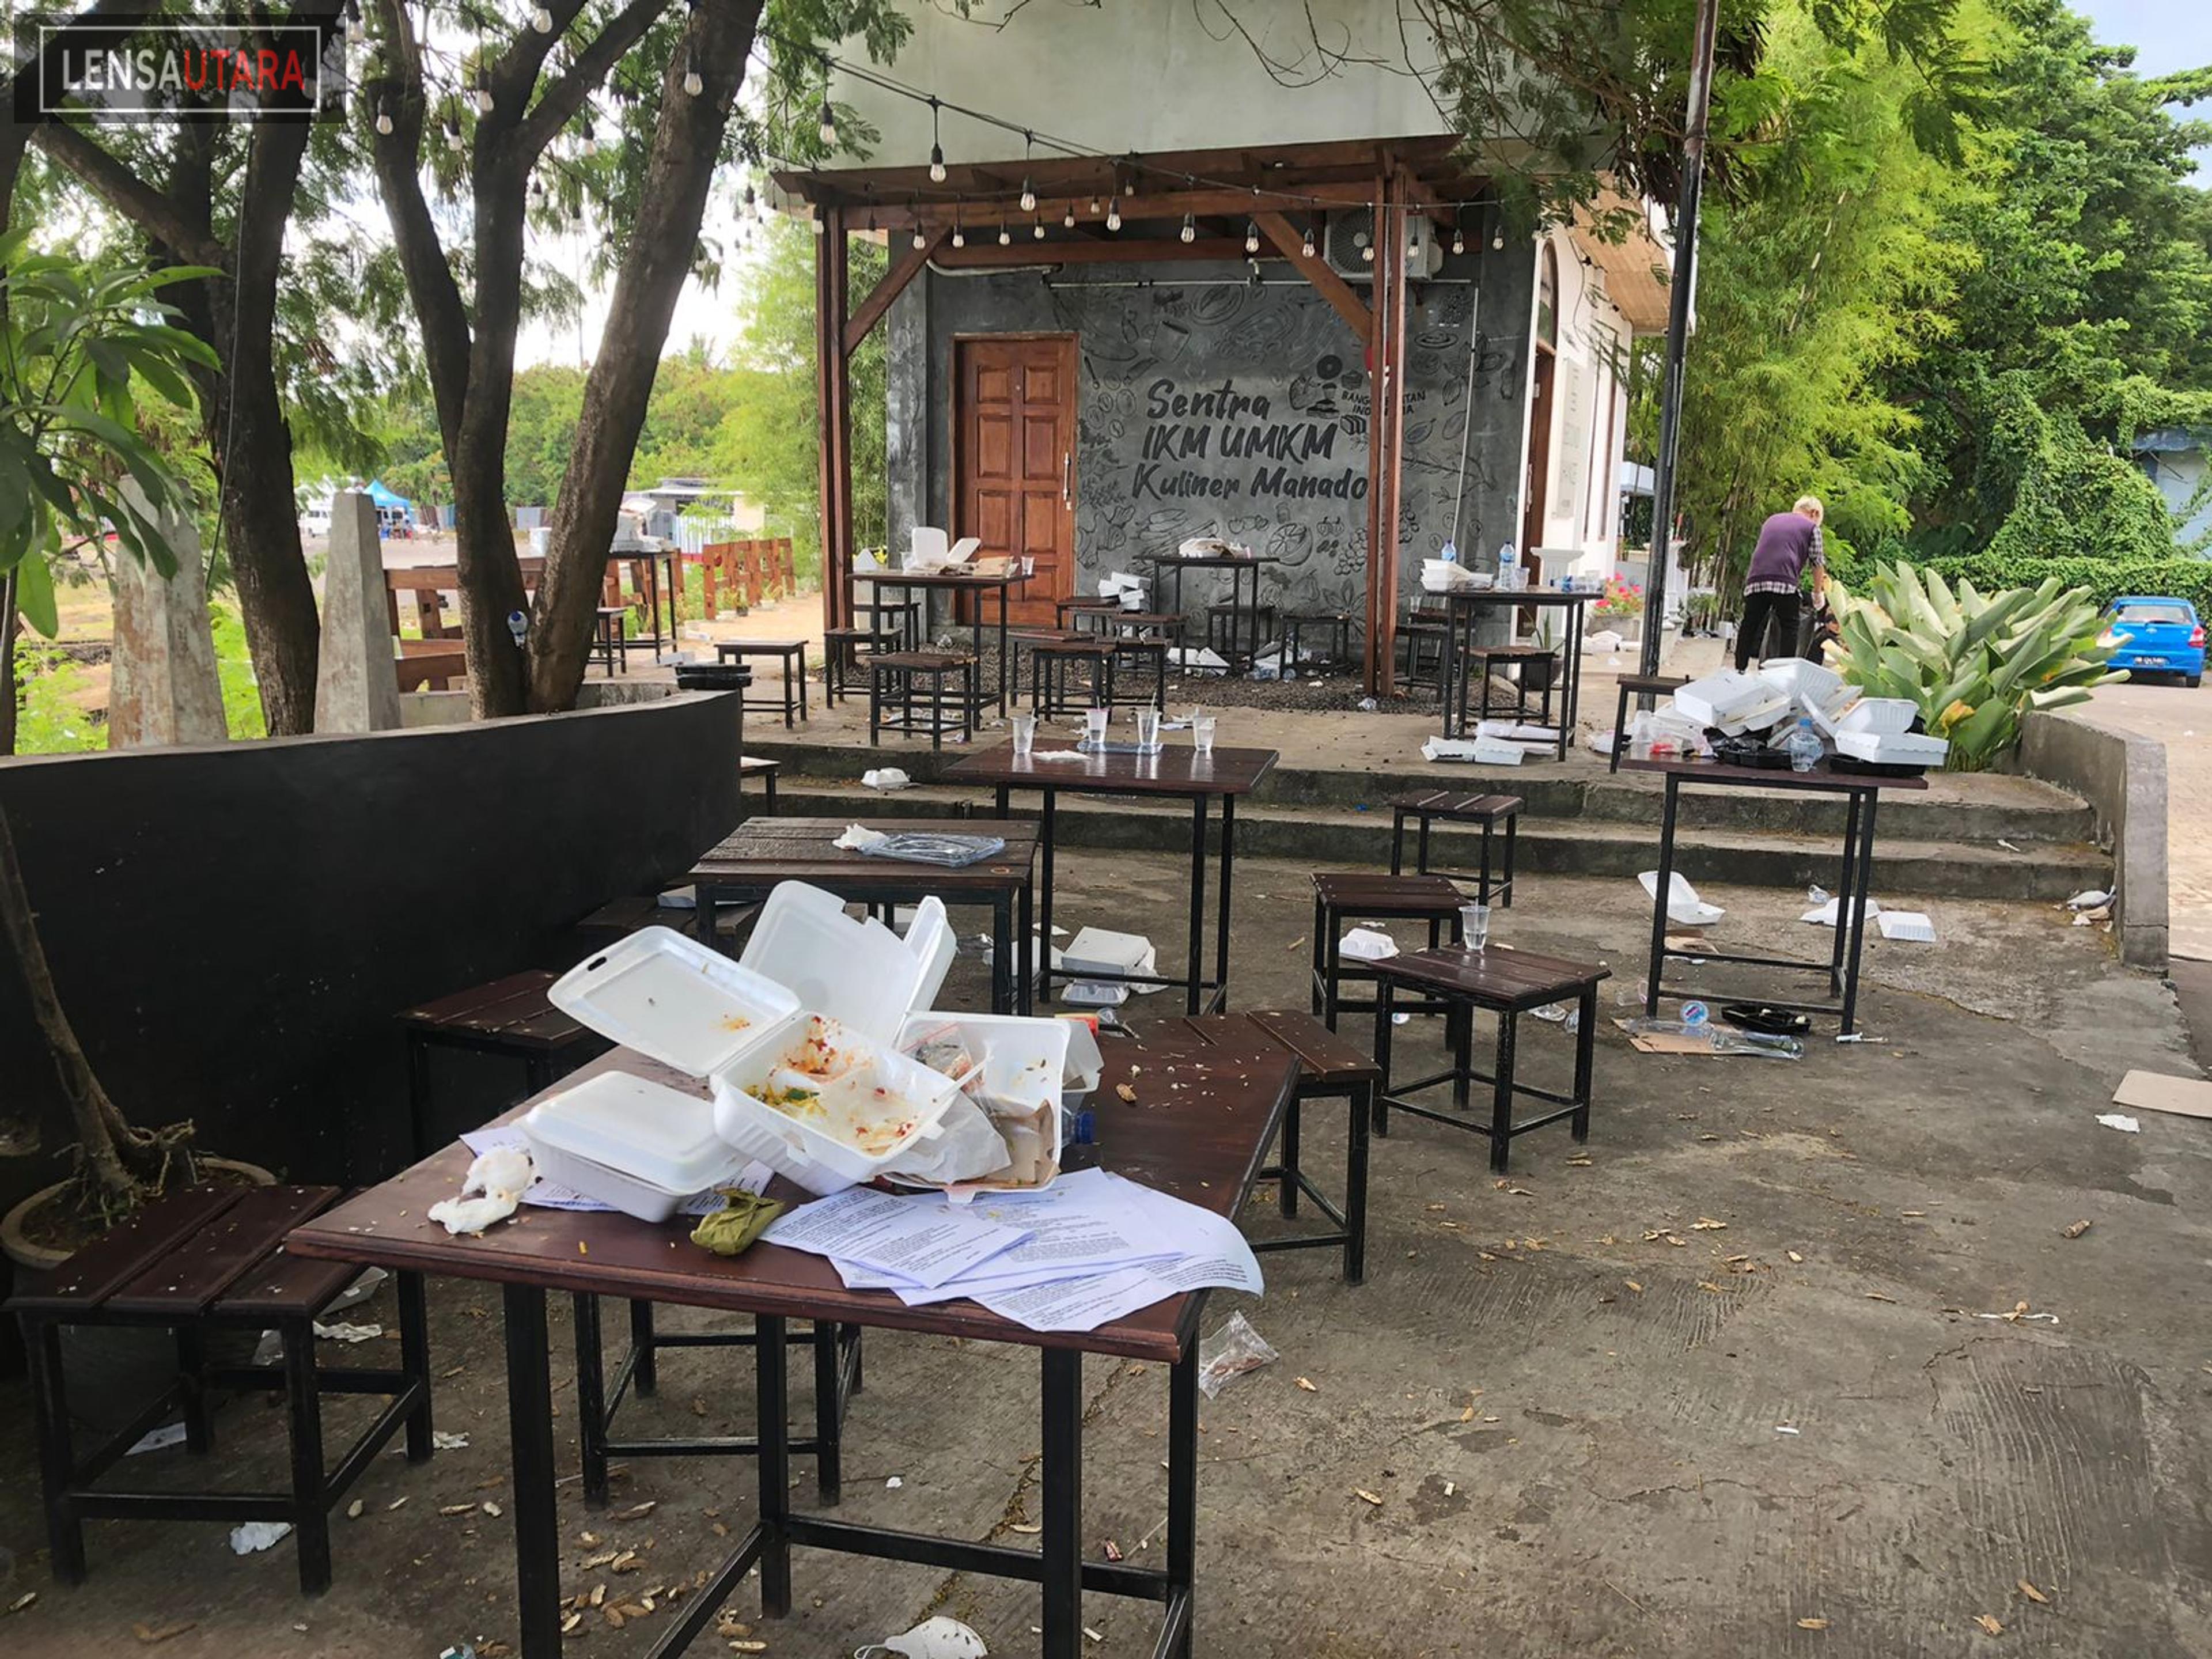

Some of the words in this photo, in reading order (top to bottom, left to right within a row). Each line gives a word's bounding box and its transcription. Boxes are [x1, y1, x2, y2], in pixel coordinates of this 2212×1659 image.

[1147, 378, 1271, 421] Sentra
[1142, 424, 1211, 461] IKM
[1220, 423, 1338, 465] UMKM
[1131, 463, 1240, 501] Kuliner
[1249, 466, 1369, 500] Manado
